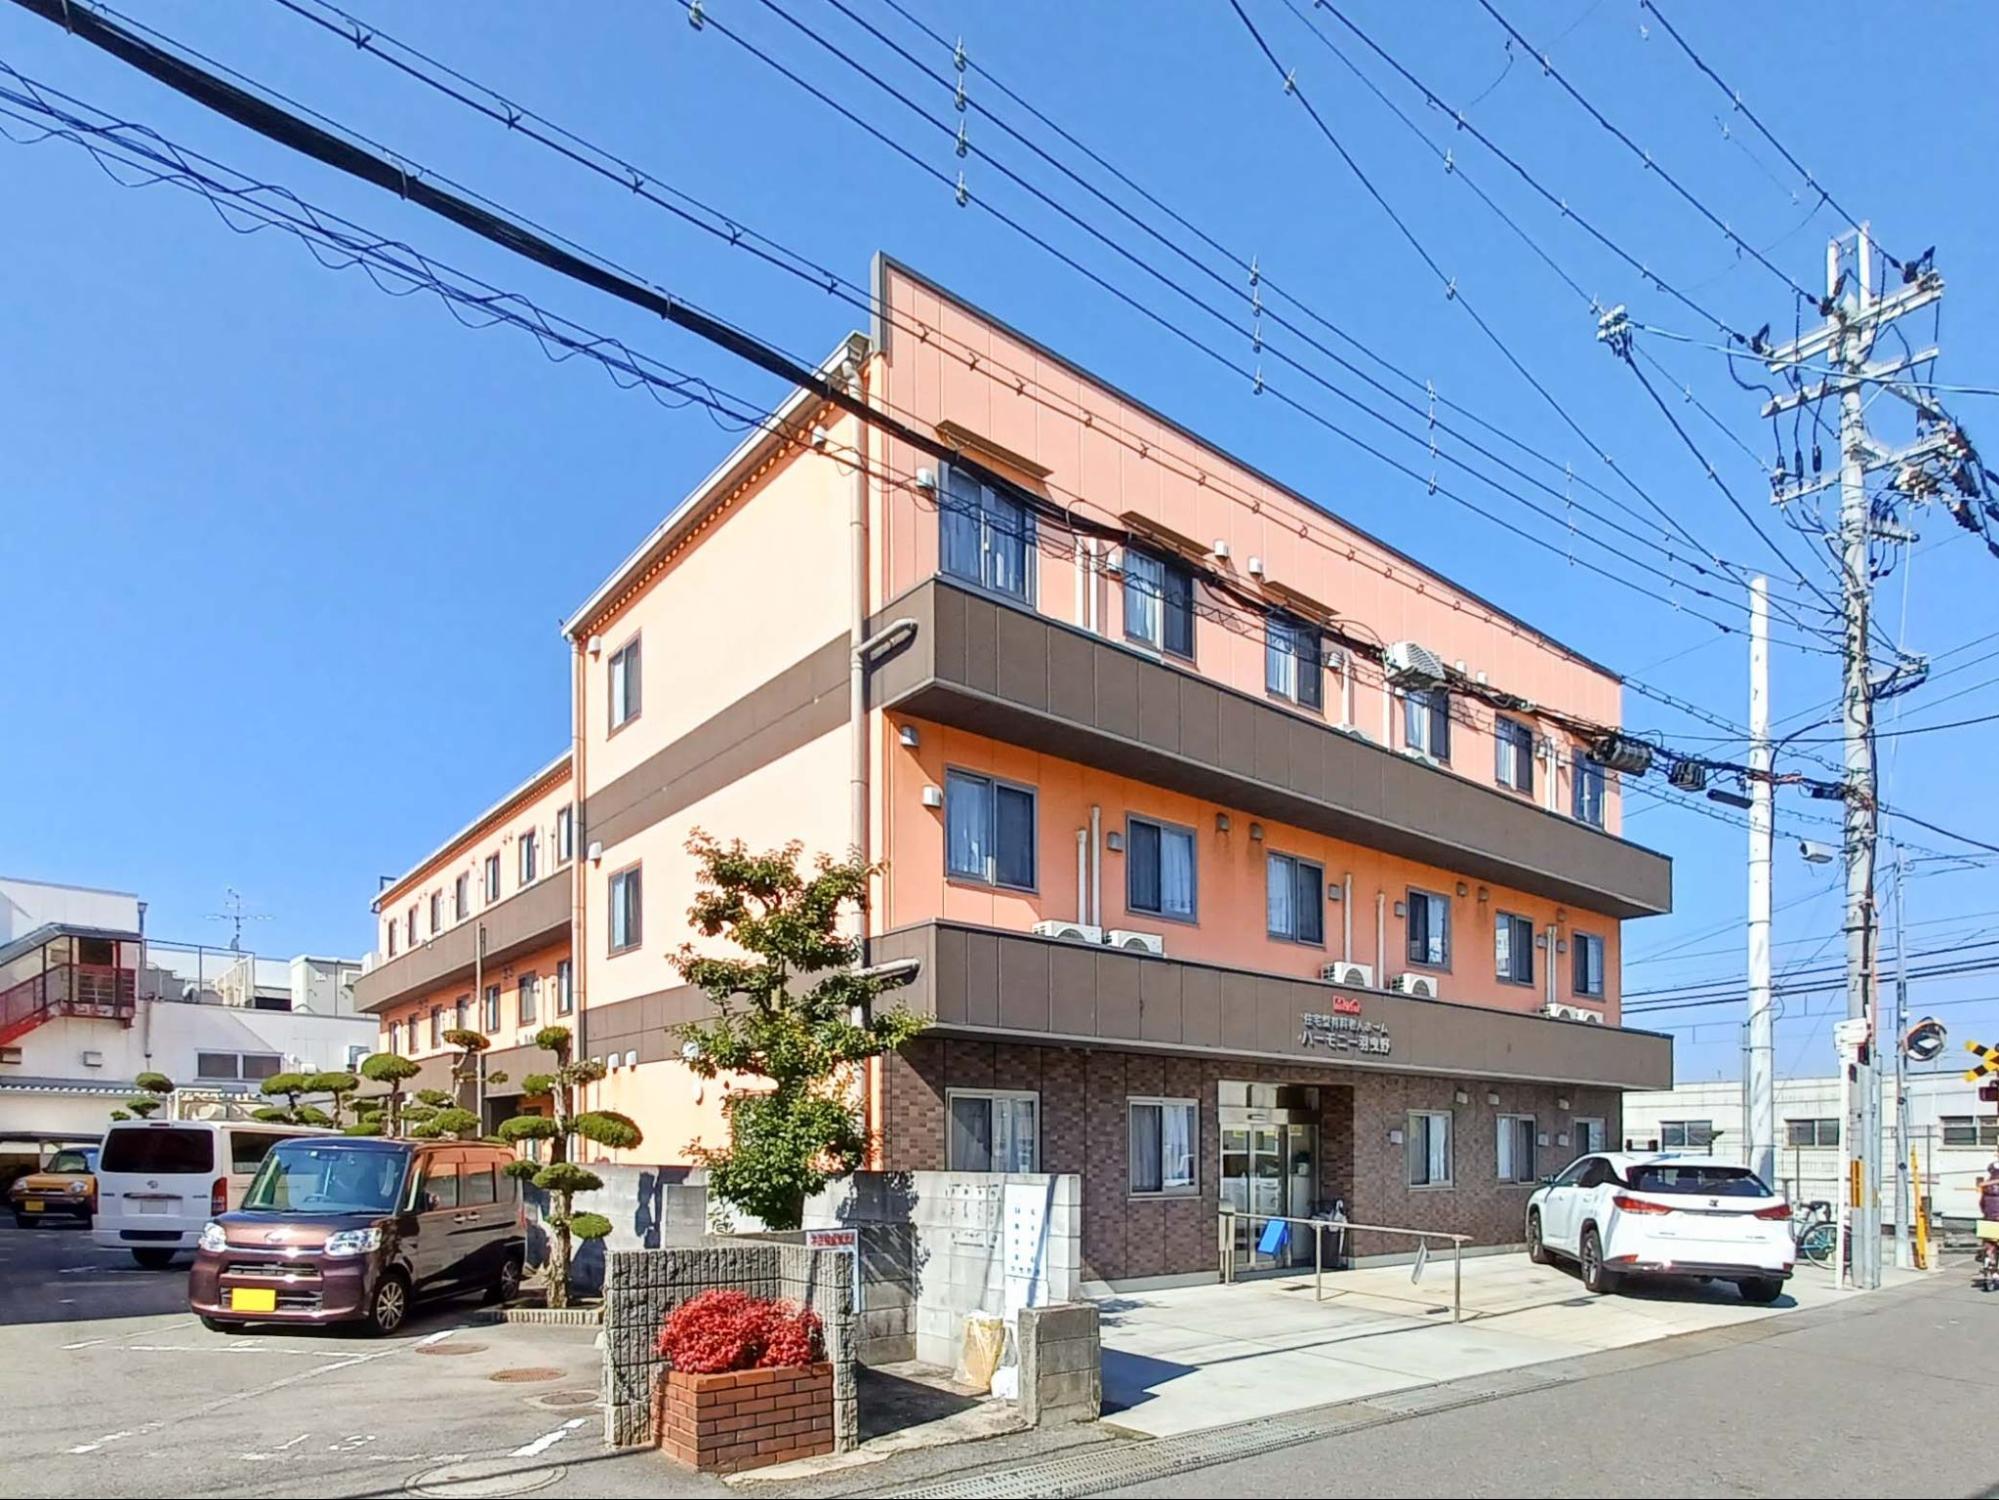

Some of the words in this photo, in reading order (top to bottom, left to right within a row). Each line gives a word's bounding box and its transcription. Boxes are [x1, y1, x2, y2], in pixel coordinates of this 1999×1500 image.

[1301, 1031, 1390, 1053] ハーモニー羽曳野
